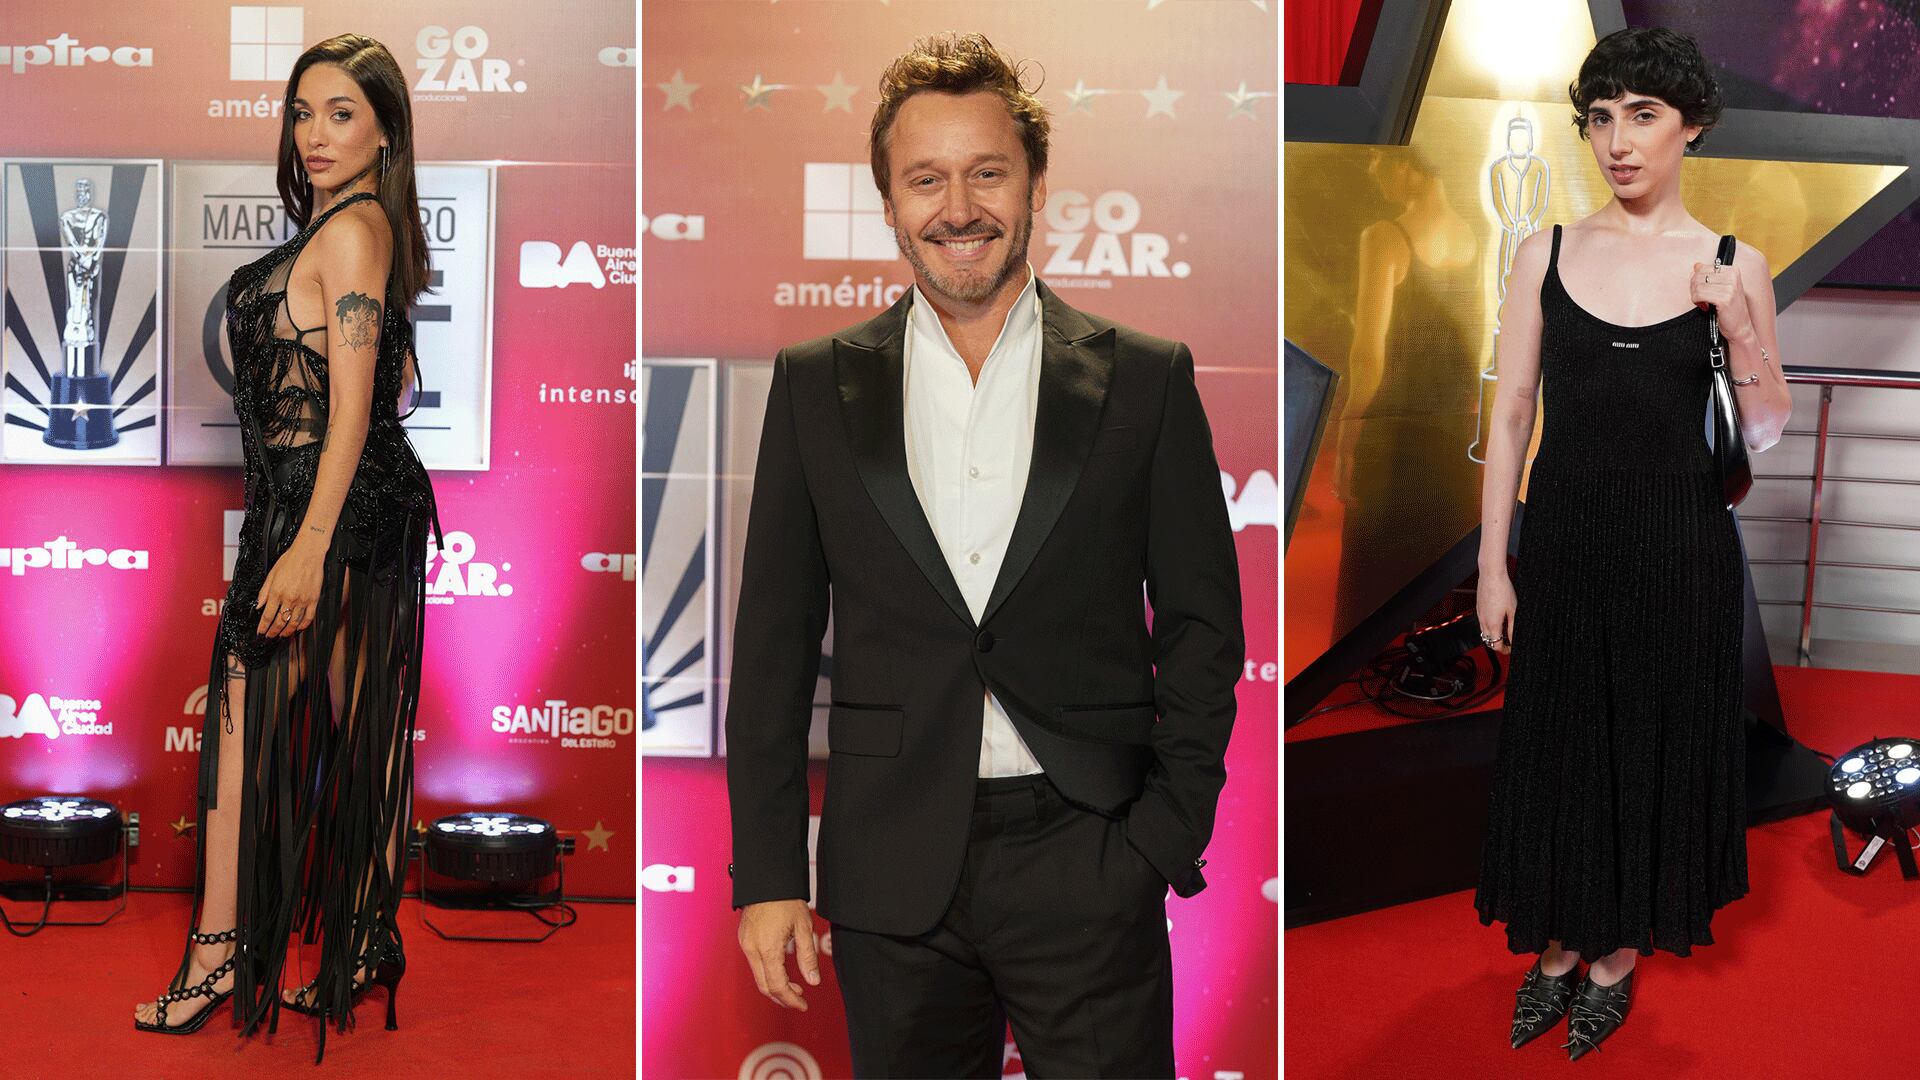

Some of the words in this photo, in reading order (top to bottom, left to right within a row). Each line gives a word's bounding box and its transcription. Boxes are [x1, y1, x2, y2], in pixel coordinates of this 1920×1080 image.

[0, 33, 153, 74] ptra
[415, 25, 489, 59] GO
[207, 93, 283, 118] amér
[1045, 189, 1141, 234] GO
[519, 240, 607, 290] BA
[596, 244, 636, 258] Buen
[609, 271, 636, 285] Ciu
[0, 536, 149, 576] ptra
